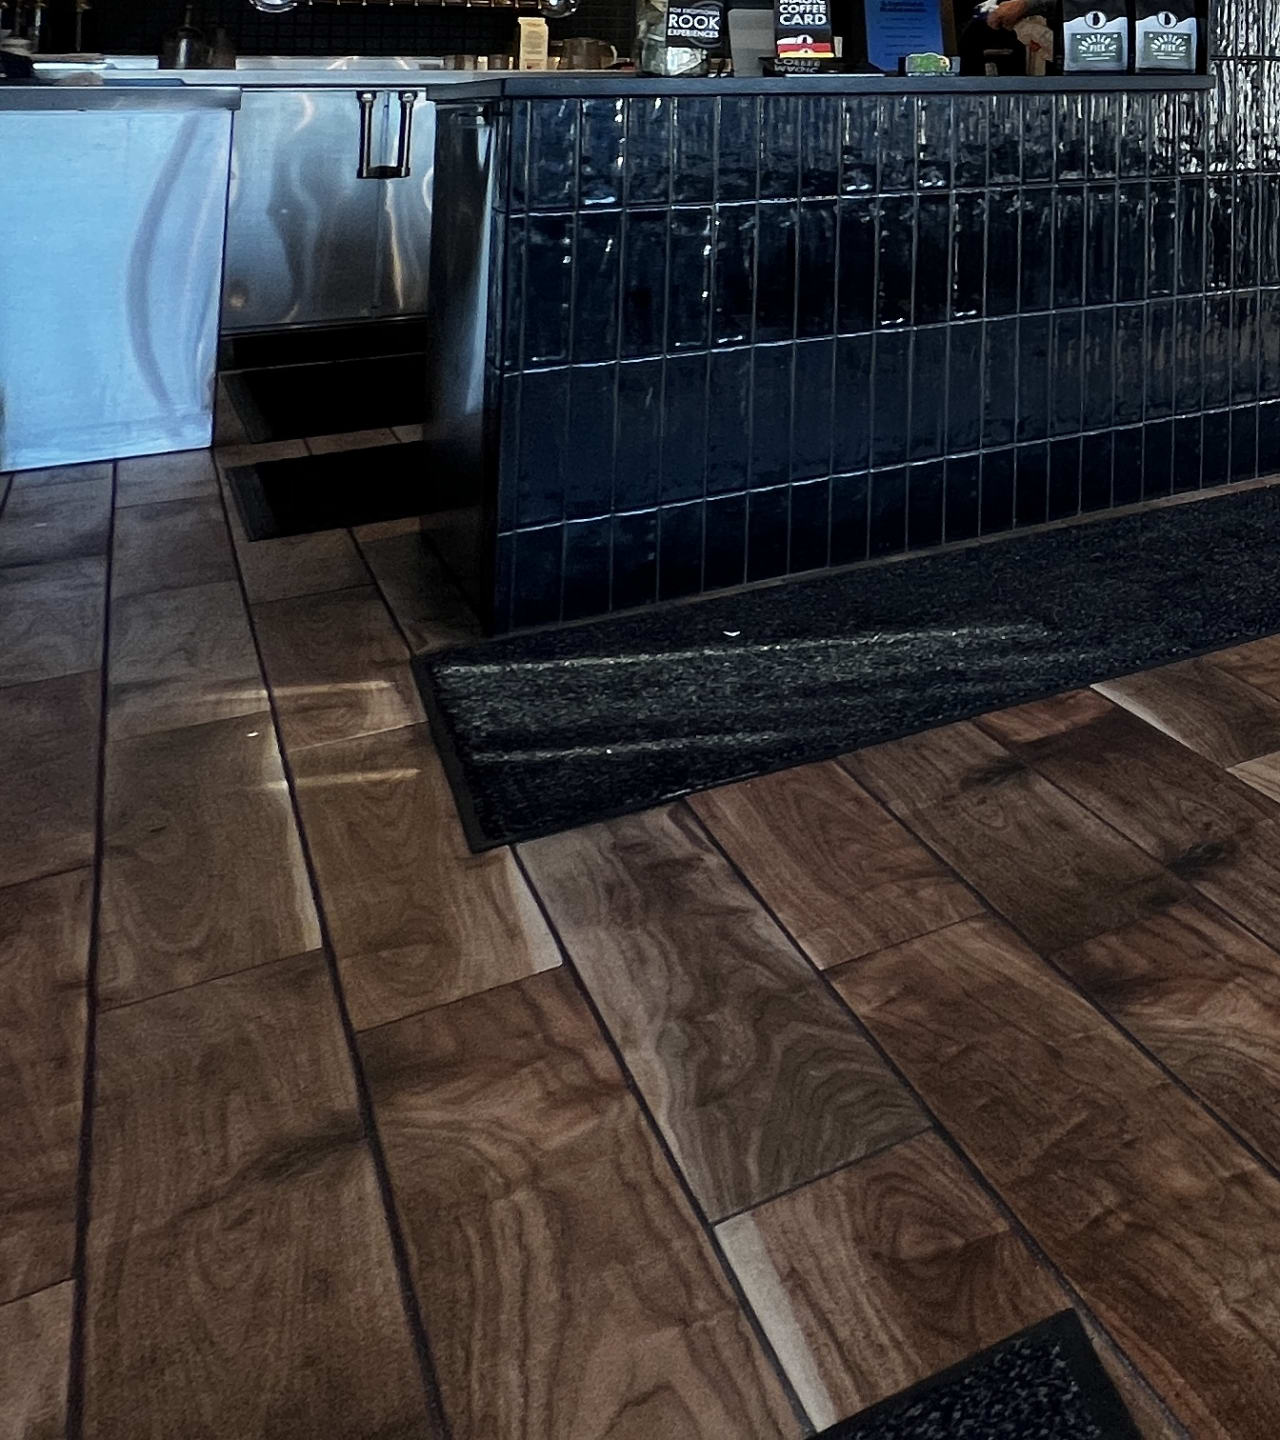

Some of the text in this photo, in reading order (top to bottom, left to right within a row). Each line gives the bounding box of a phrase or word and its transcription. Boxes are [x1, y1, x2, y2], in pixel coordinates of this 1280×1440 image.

[779, 4, 827, 14] COFFEE
[668, 14, 720, 30] ROOK
[779, 13, 827, 26] CARD
